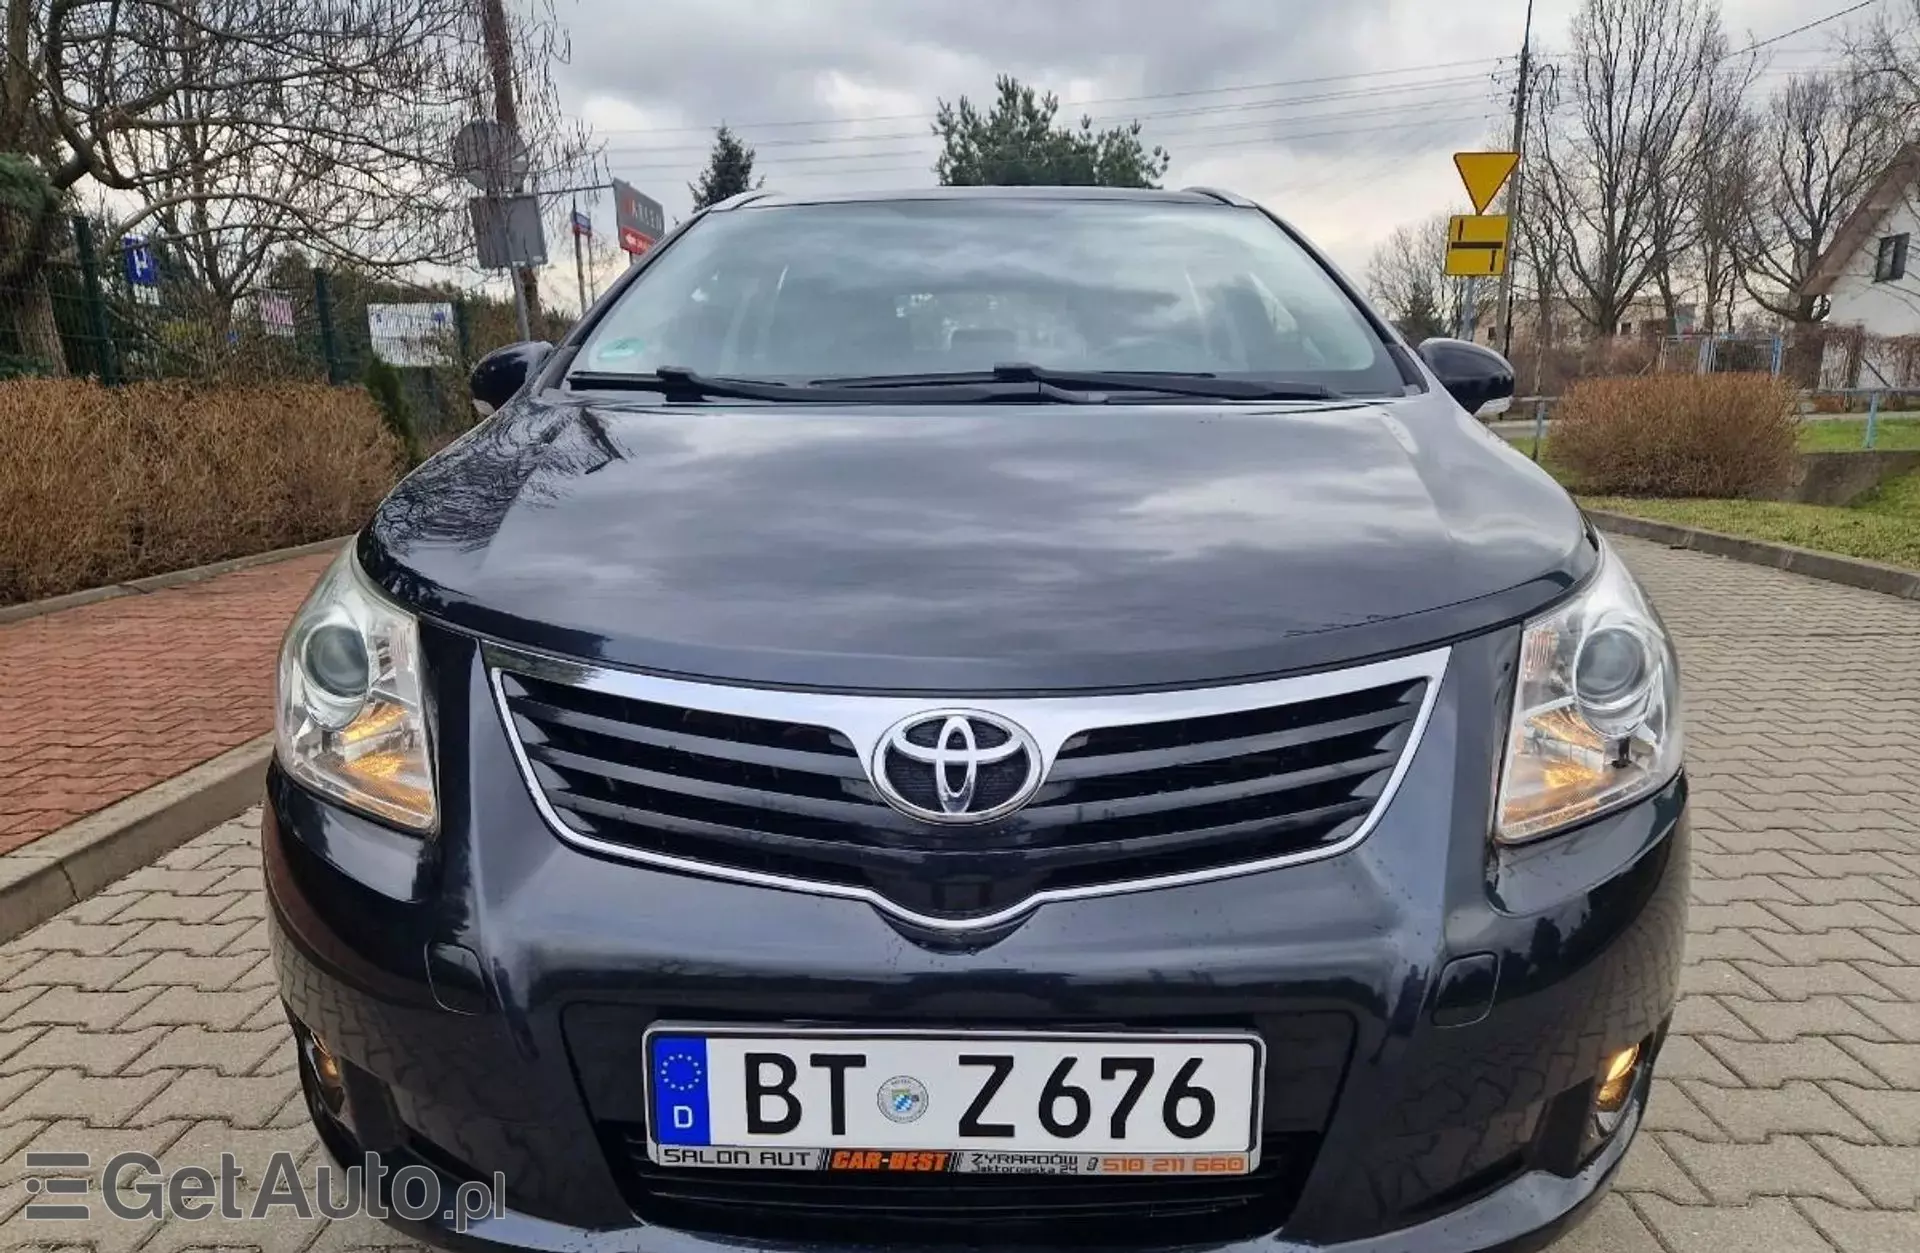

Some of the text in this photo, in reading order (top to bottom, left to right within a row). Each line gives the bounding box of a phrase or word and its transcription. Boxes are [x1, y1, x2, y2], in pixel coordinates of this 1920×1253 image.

[744, 1052, 1216, 1140] BT Z 676
[673, 1105, 693, 1128] D
[663, 1149, 948, 1170] SALON AUT CAR-BEST
[1060, 1165, 1079, 1174] 24
[1102, 1158, 1145, 1172] 510
[1151, 1158, 1185, 1172] 211
